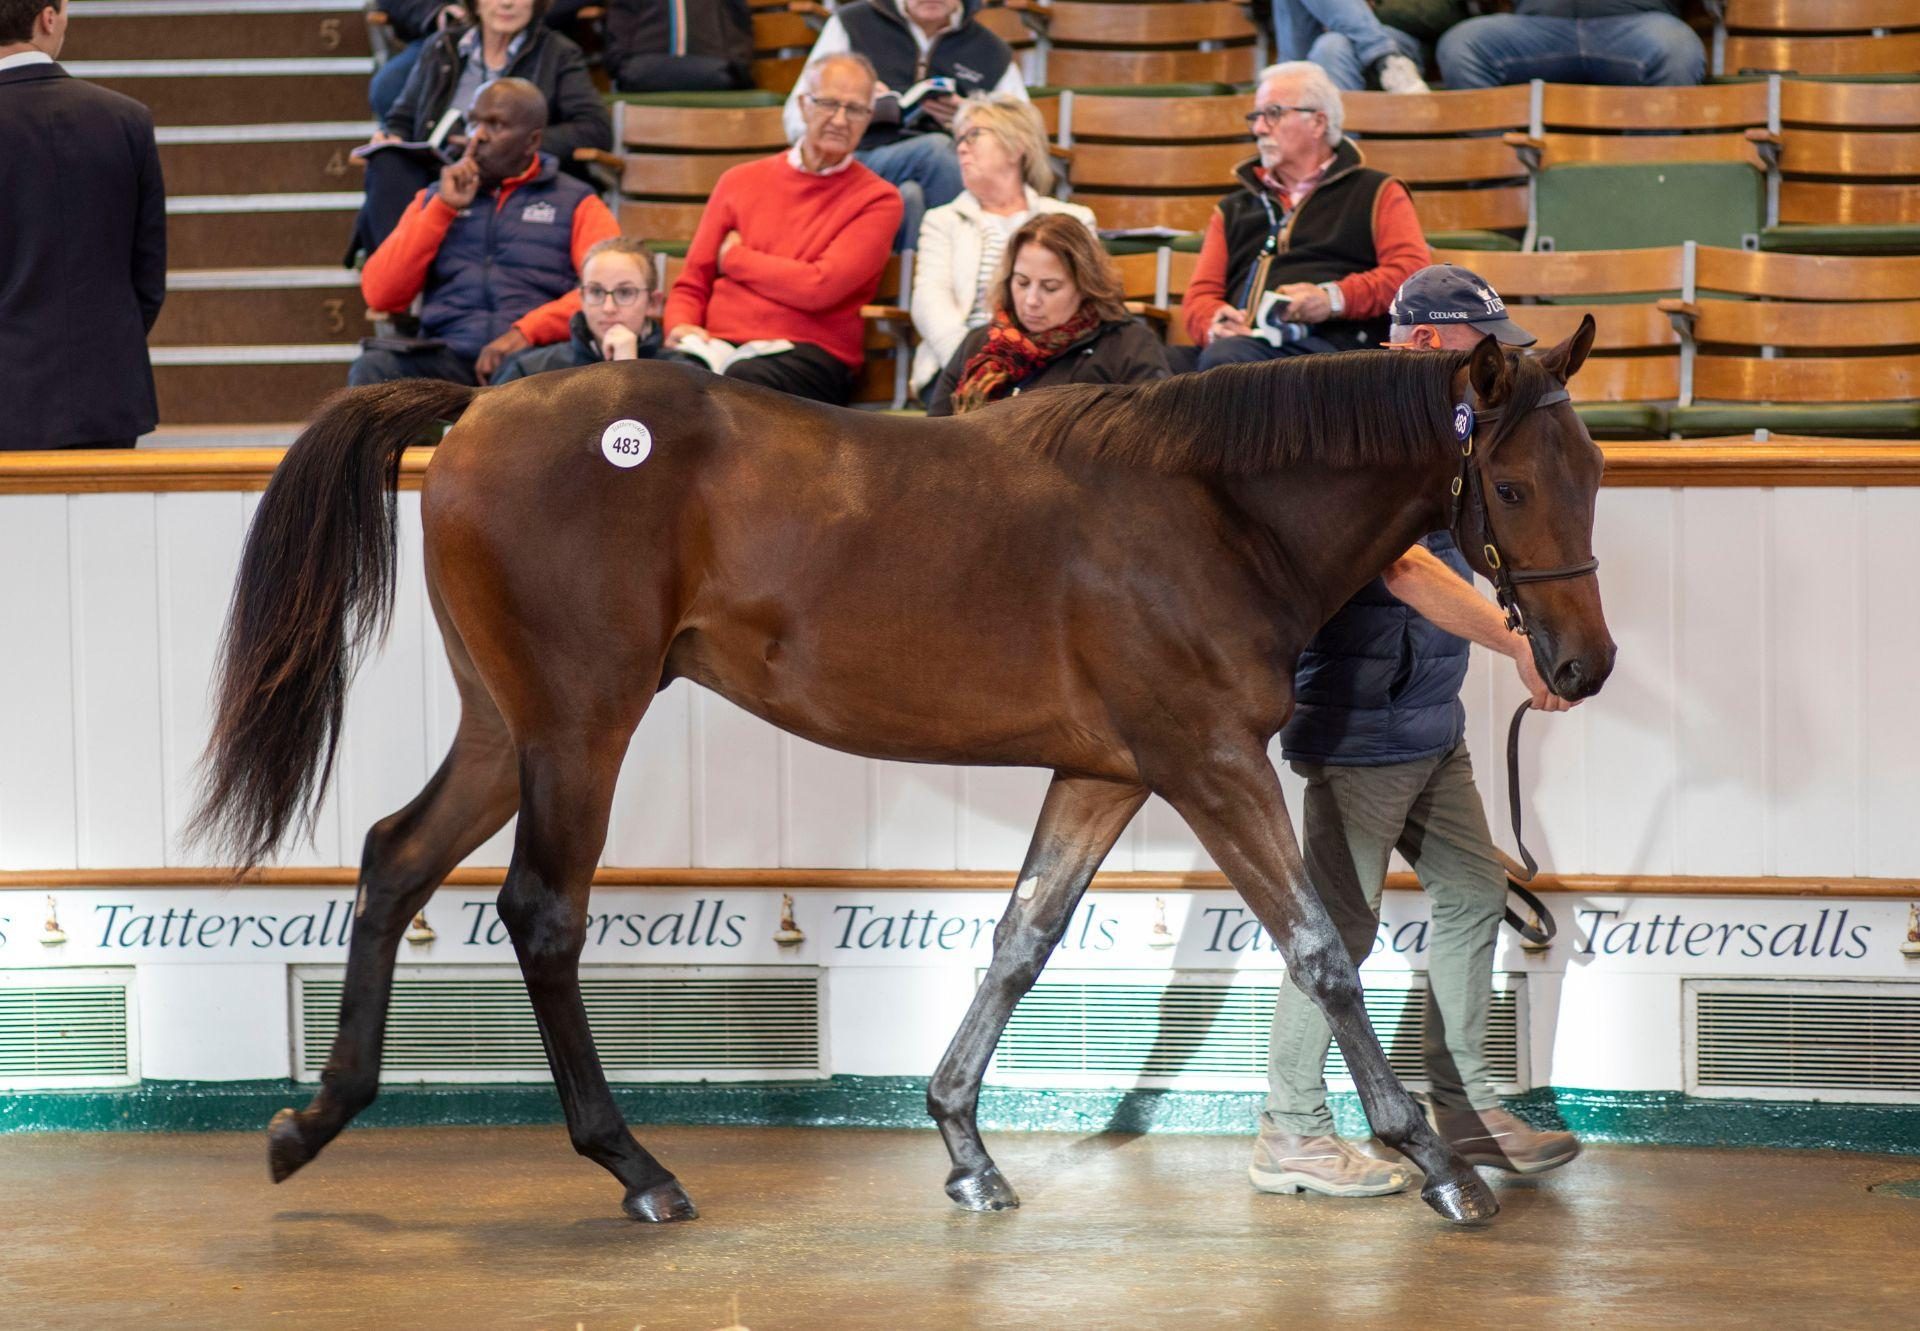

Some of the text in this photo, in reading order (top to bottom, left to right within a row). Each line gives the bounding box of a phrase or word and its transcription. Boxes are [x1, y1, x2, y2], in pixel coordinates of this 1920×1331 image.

[320, 19, 341, 50] 5
[325, 151, 347, 177] 4
[324, 299, 345, 333] 3
[1428, 311, 1469, 320] COOLMORE
[1454, 413, 1467, 435] 483
[612, 436, 640, 456] 483
[95, 900, 354, 948] Tattersall
[834, 902, 1119, 952] Tatterls
[1577, 907, 1873, 960] Tattersalls
